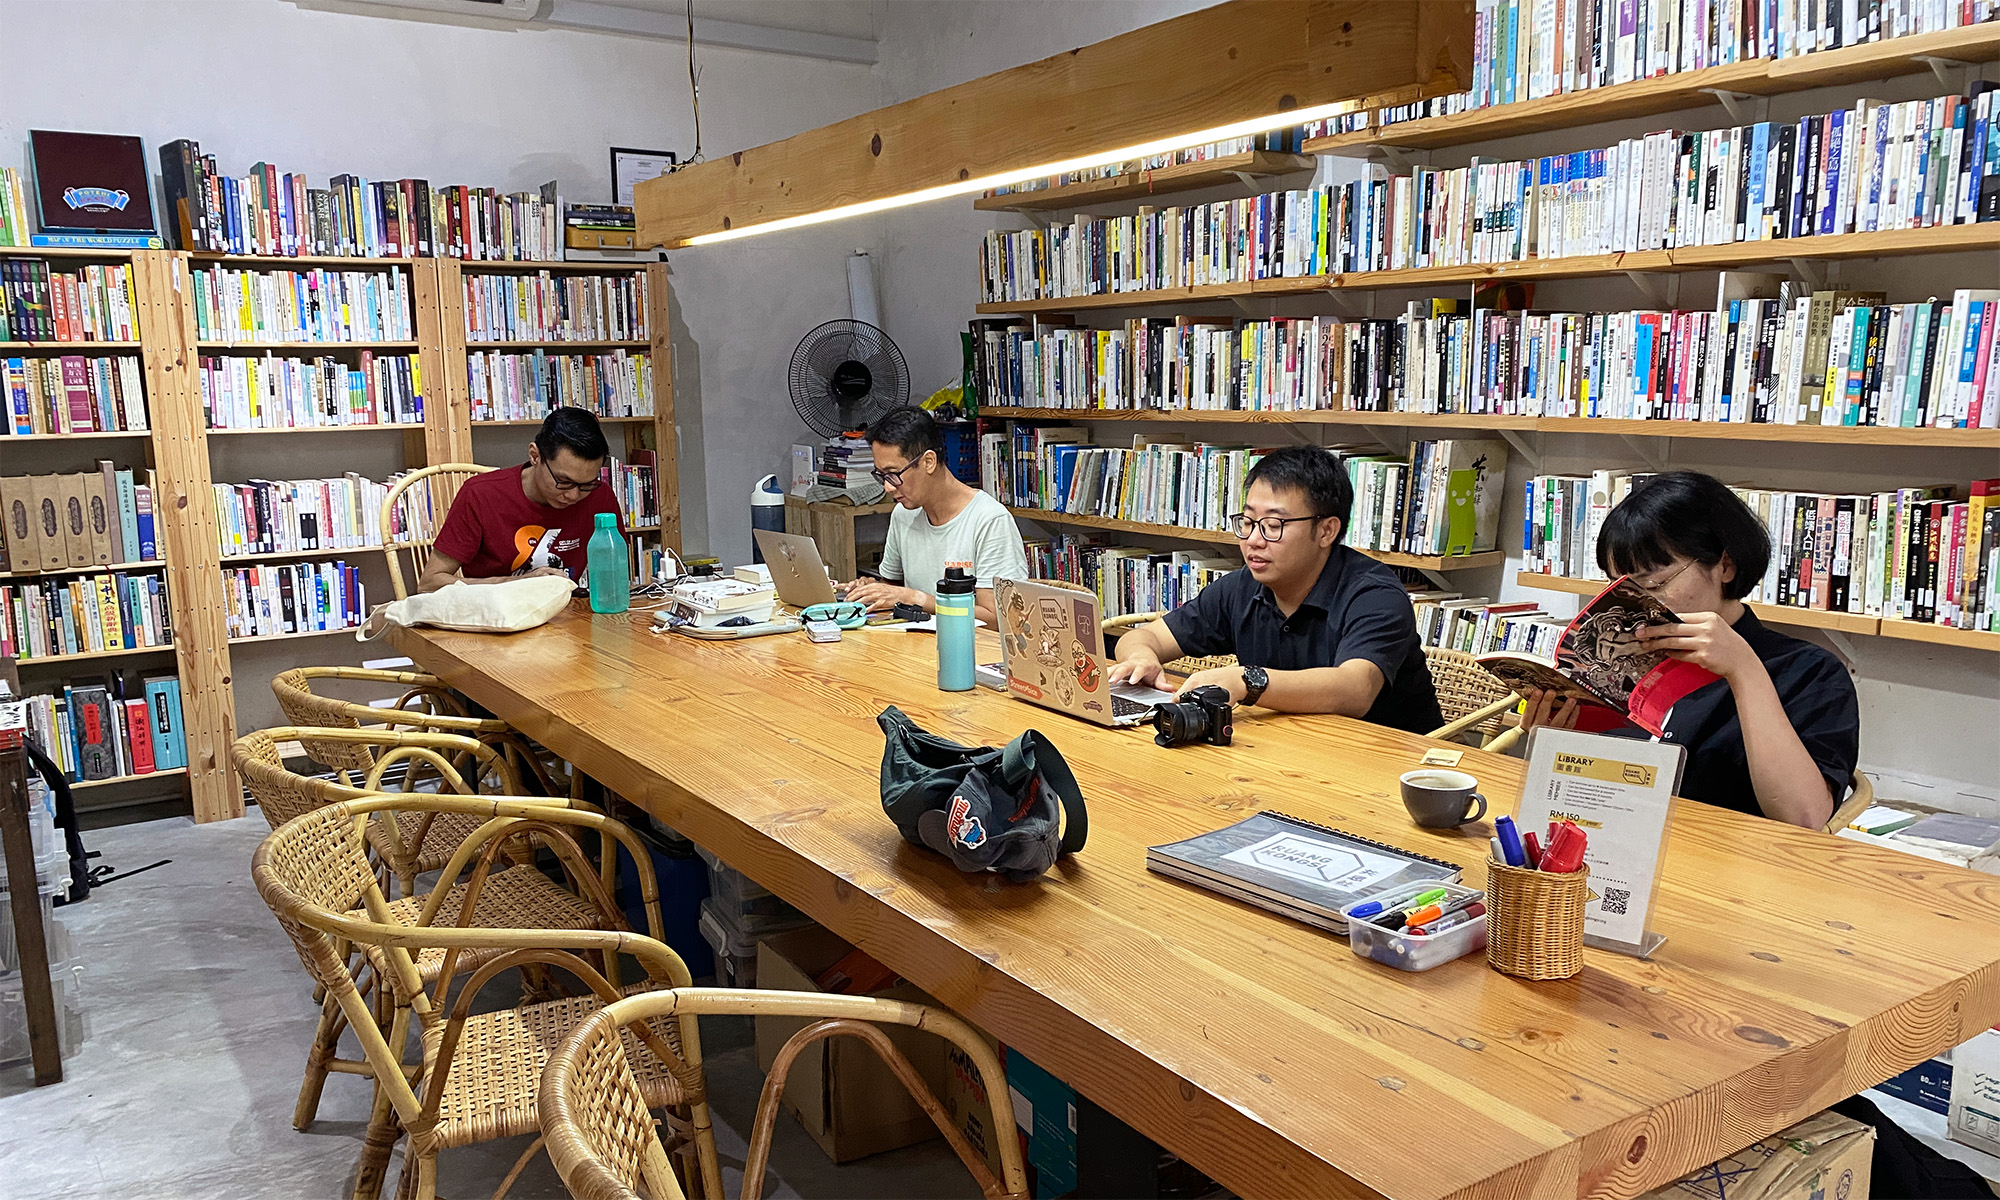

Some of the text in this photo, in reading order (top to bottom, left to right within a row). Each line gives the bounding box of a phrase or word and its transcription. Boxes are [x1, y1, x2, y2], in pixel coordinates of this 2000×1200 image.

[87, 236, 112, 244] WORLD
[1650, 335, 1660, 370] Facebook
[1803, 509, 1816, 551] 低端人口
[1558, 754, 1595, 766] LiBRARY
[1547, 779, 1555, 800] LIBRARY
[1549, 809, 1565, 820] RM
[1566, 812, 1580, 822] 150
[1262, 850, 1328, 869] KONGSI
[1271, 844, 1333, 864] RUANG
